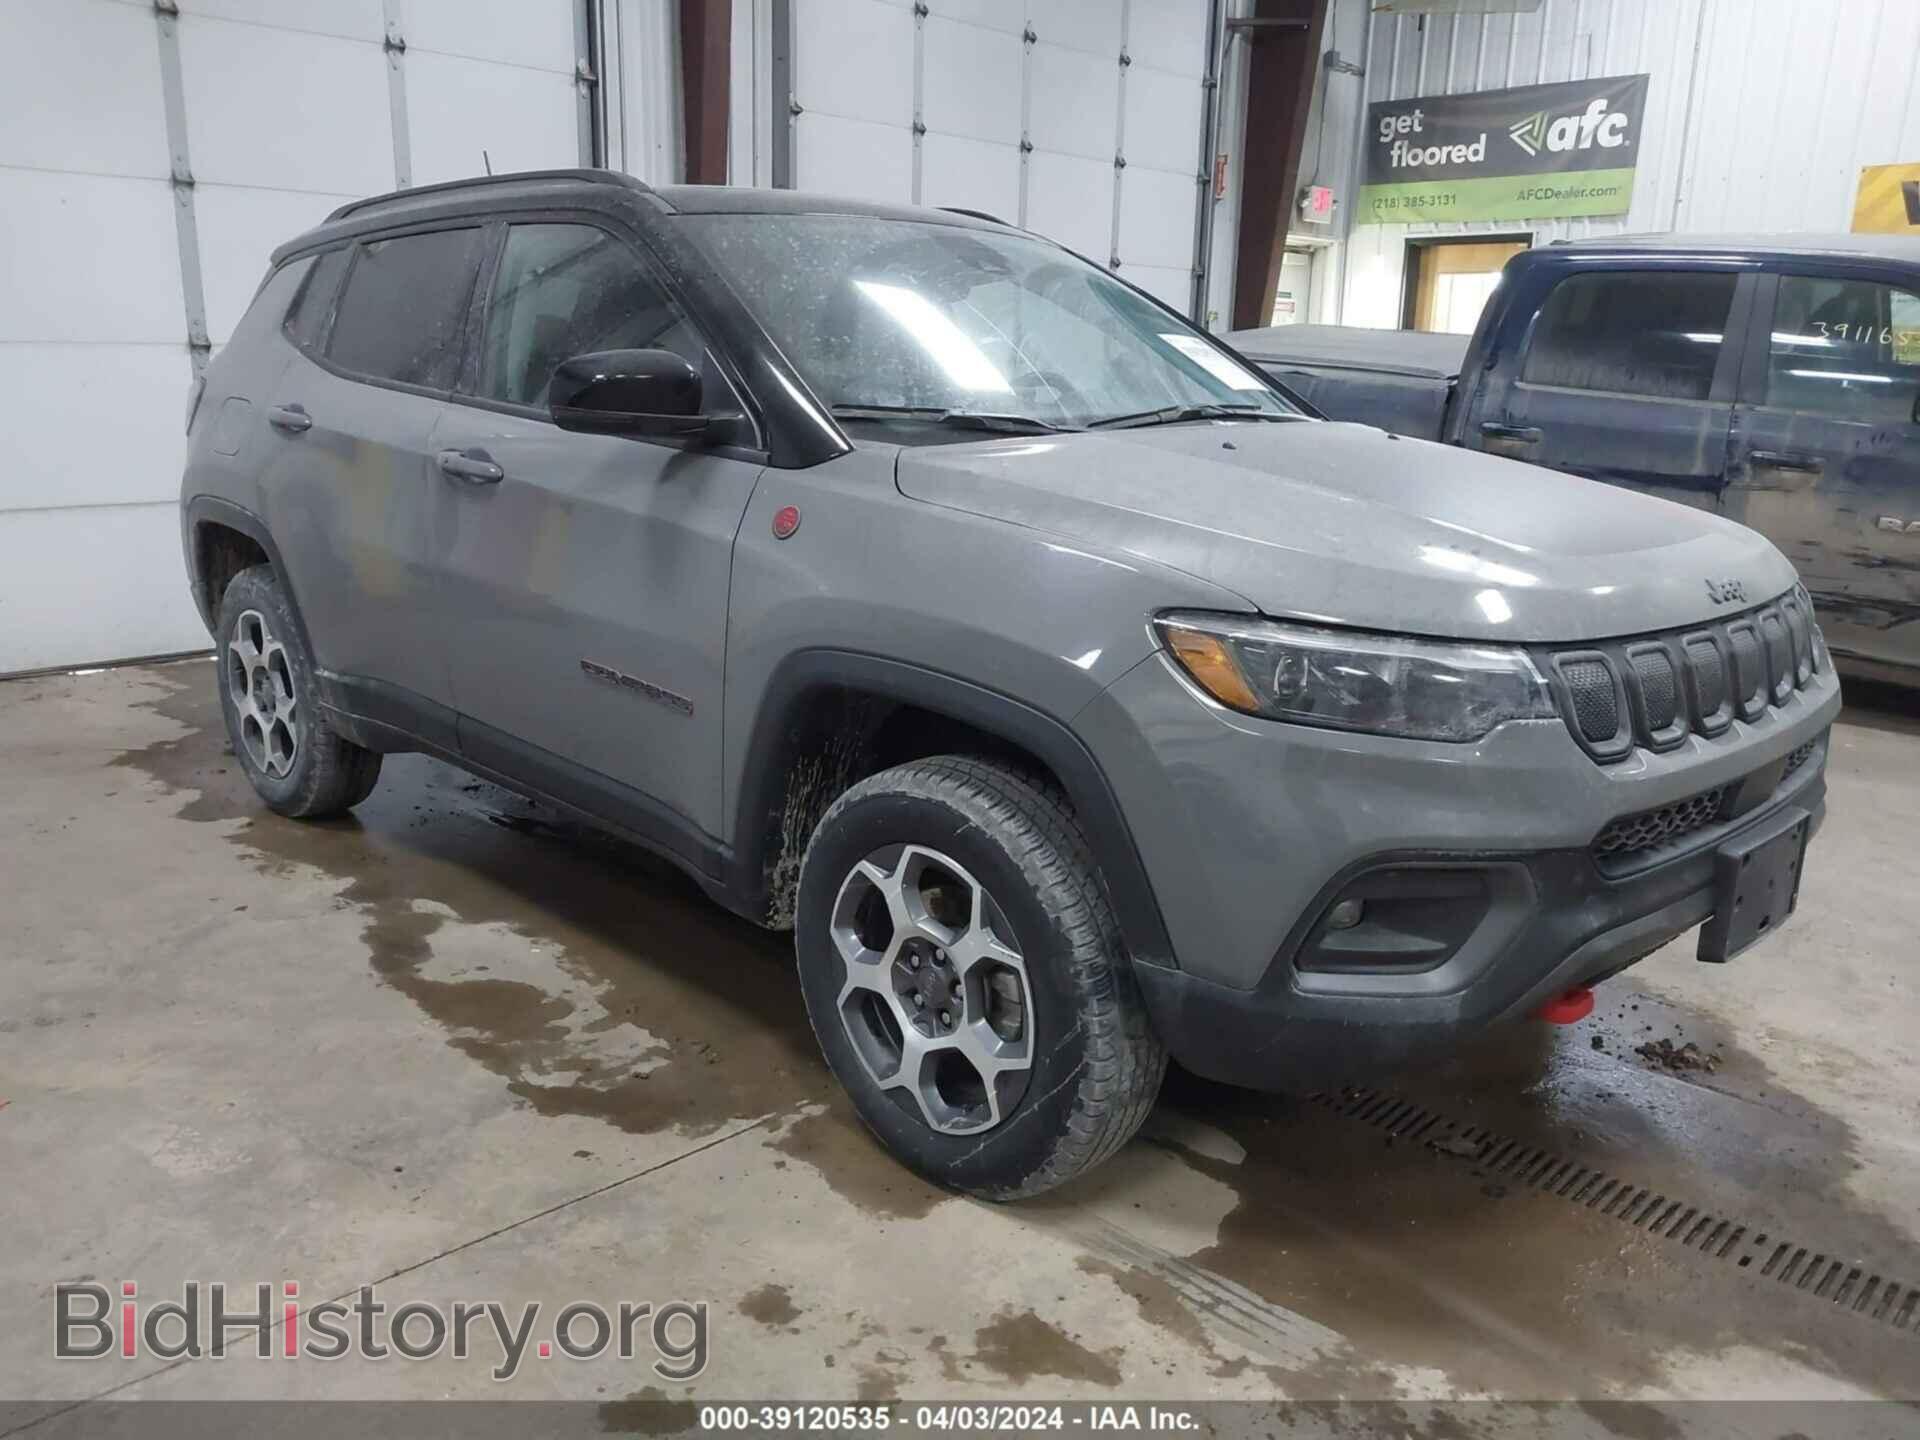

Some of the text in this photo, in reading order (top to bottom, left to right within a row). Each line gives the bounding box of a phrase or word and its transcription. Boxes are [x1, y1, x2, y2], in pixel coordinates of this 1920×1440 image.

[1379, 109, 1424, 142] get
[1547, 99, 1627, 152] afc
[1391, 133, 1487, 168] floored
[1372, 194, 1457, 210] (218) 385-3131
[1517, 185, 1618, 202] AFCDealer.com
